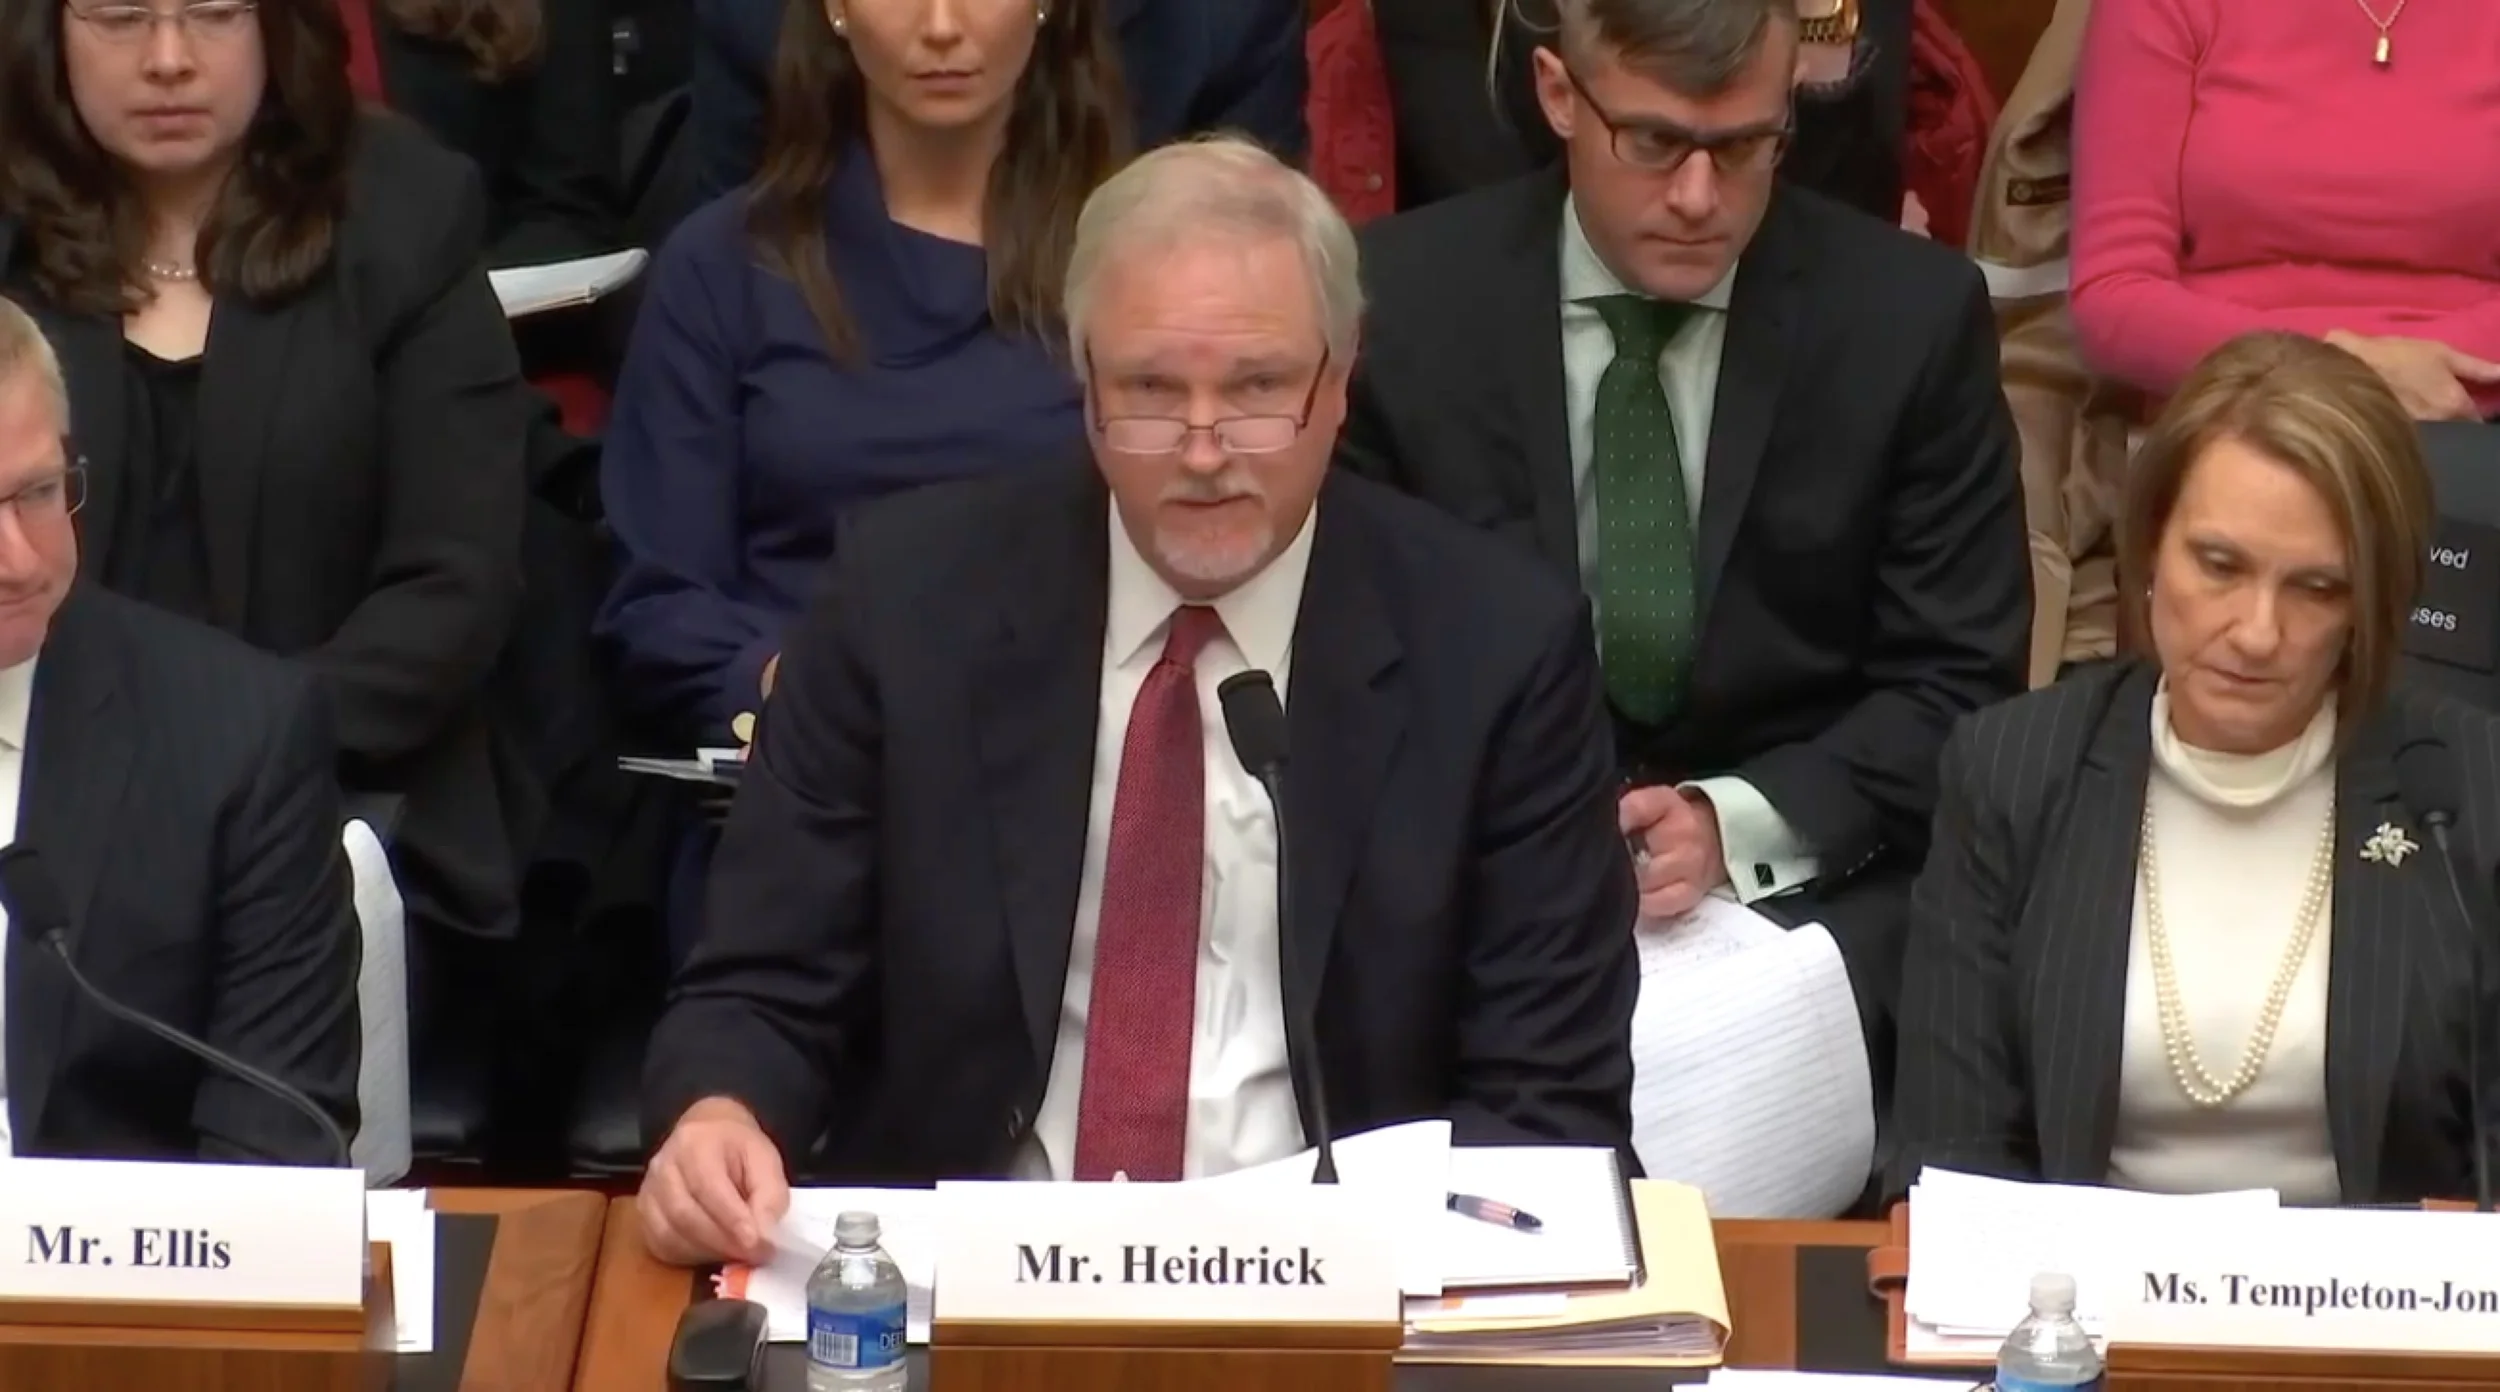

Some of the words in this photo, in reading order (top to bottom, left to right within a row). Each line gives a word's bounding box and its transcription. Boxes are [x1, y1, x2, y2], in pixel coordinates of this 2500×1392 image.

[2430, 545, 2469, 569] ved
[25, 1224, 113, 1266] Mr.
[129, 1227, 232, 1269] Ellis
[1015, 1243, 1103, 1284] Mr.
[1120, 1244, 1327, 1286] Heidrick
[2142, 1271, 2208, 1304] Ms.
[2221, 1273, 2499, 1317] Templeton-Jon
